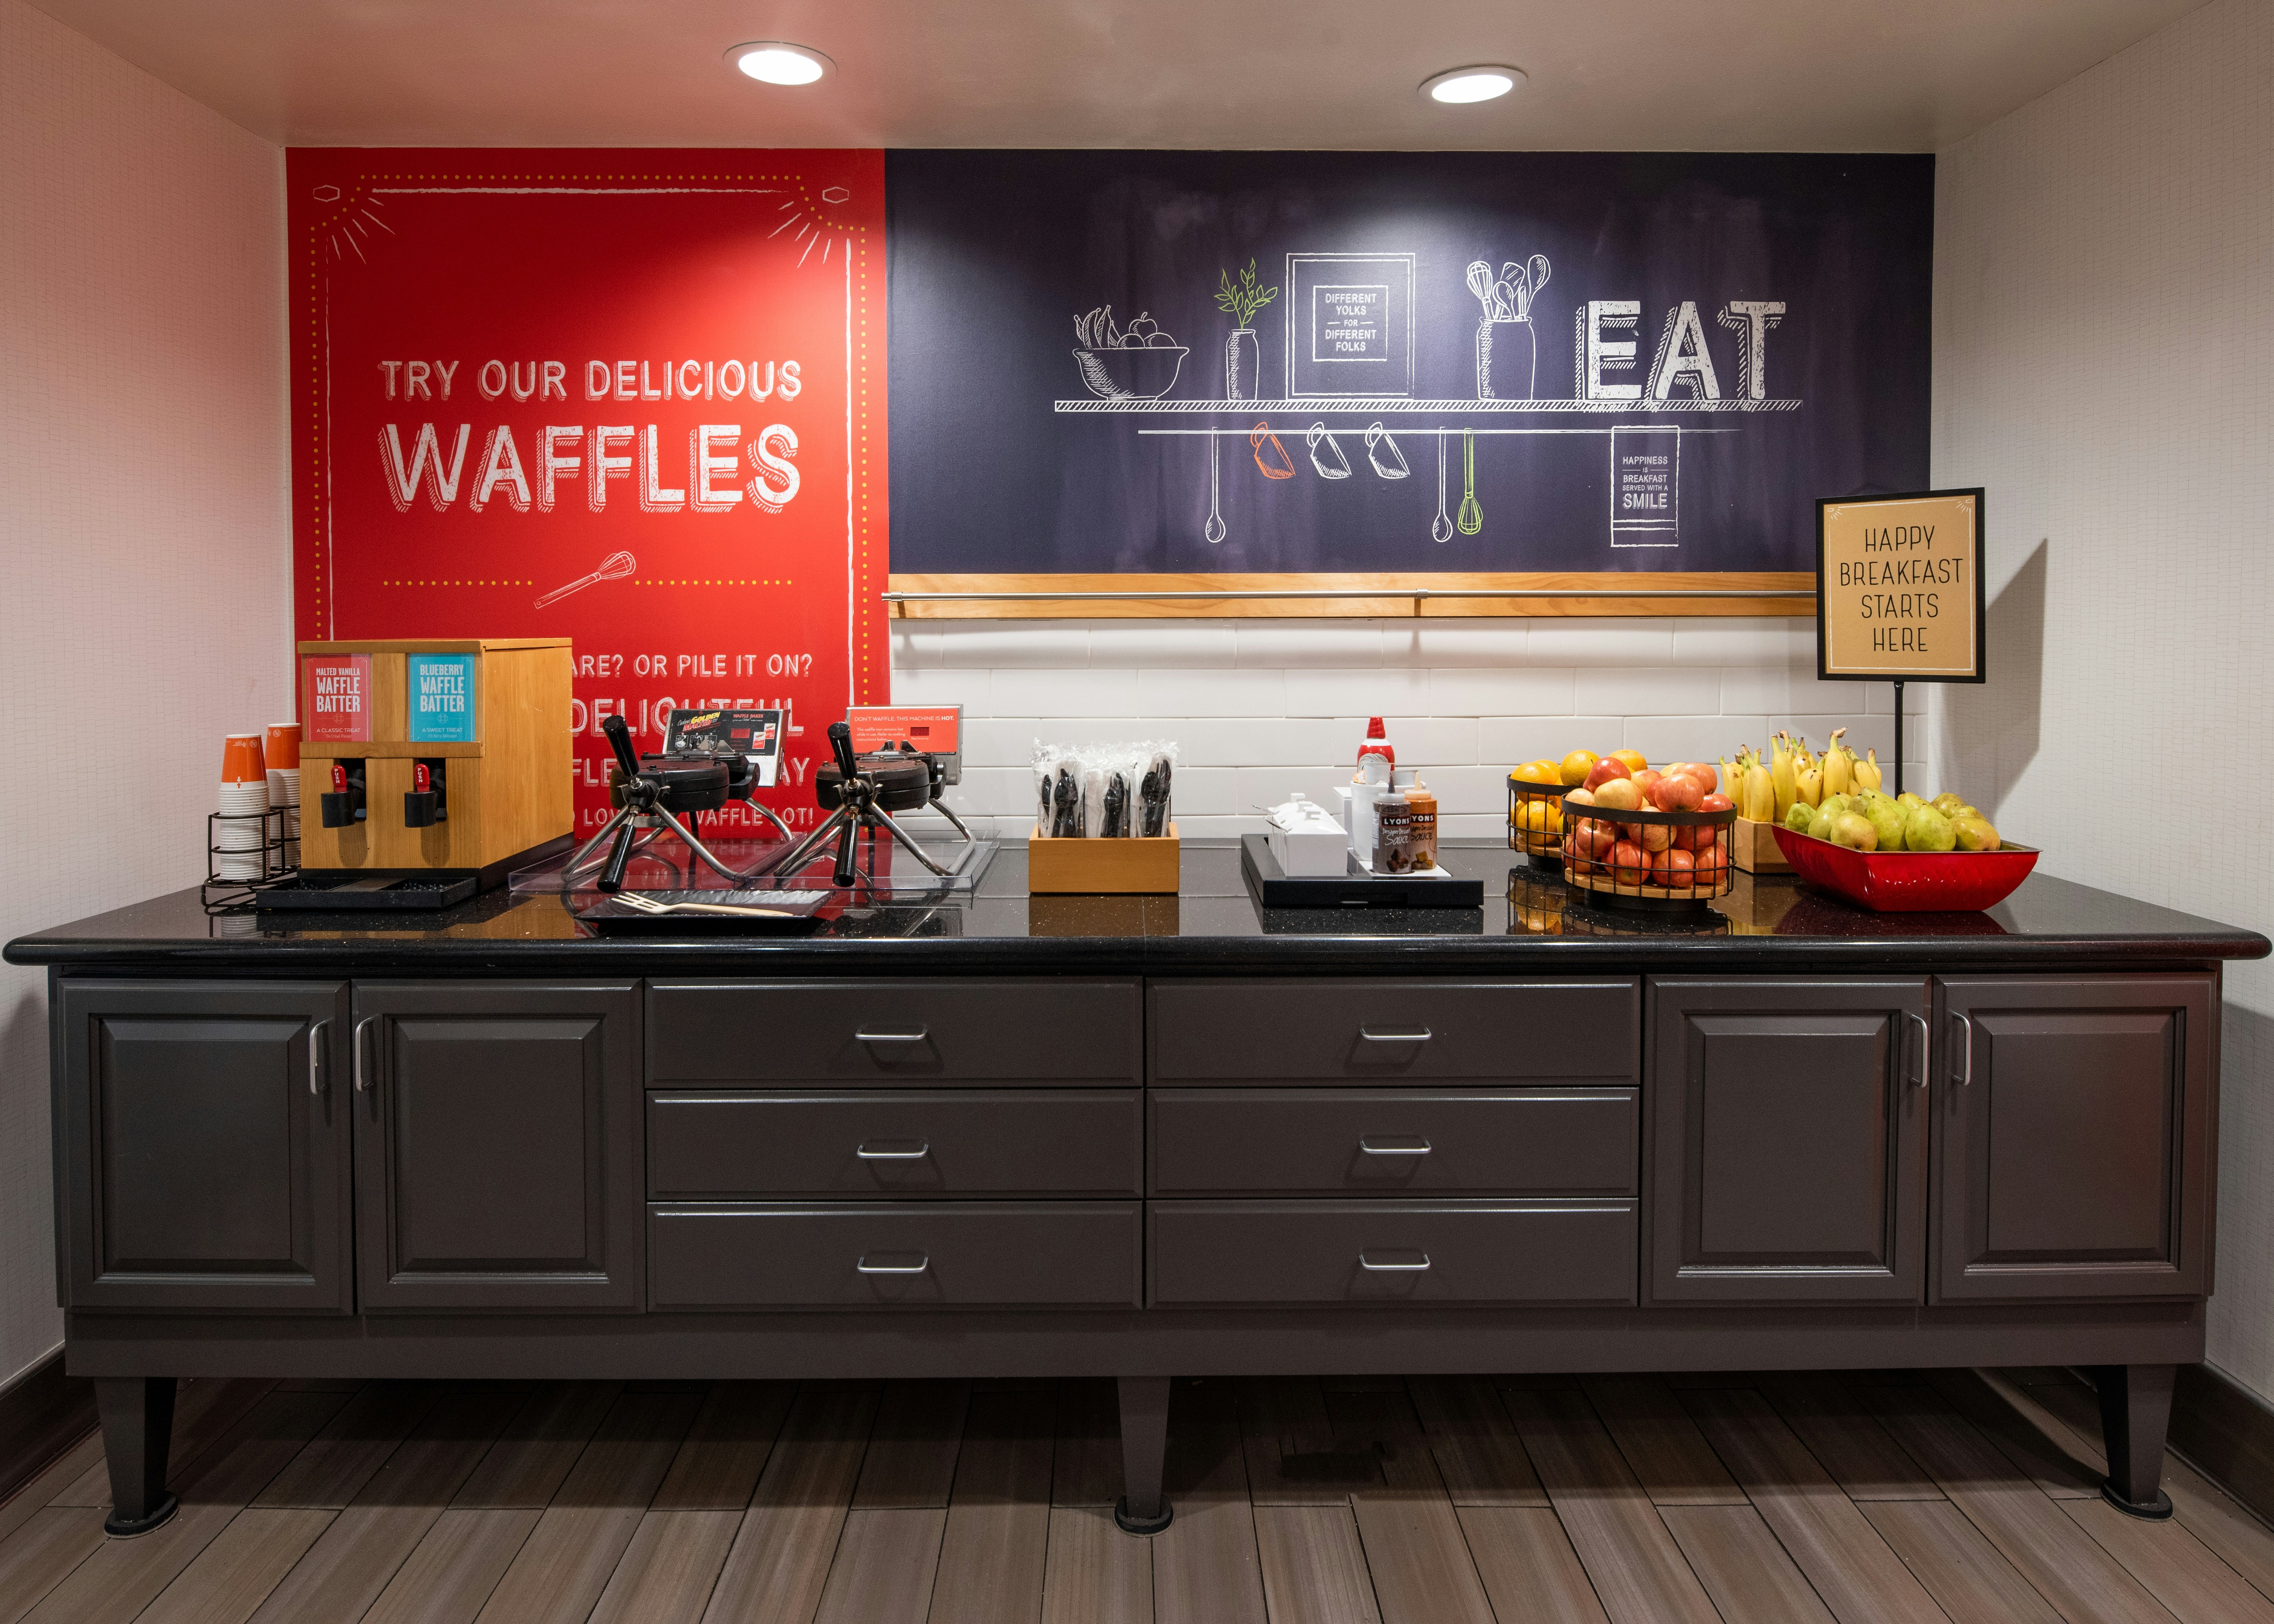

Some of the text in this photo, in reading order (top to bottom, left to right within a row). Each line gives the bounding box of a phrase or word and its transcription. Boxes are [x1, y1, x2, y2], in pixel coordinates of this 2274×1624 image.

[1325, 294, 1376, 303] DIFFERENT
[1336, 305, 1366, 315] YOLKS
[1325, 330, 1376, 340] DIFFERENT
[1336, 341, 1366, 352] FOLKS
[1576, 301, 1786, 410] EAT
[378, 359, 802, 402] TRY OUR DELICIOUS
[378, 423, 800, 514] WAFFLES
[1623, 456, 1668, 465] HAPPINESS
[1623, 475, 1667, 483] BREAKFAST
[1622, 493, 1667, 510] SMILE
[1865, 525, 1935, 552] HAPPY
[1840, 558, 1963, 586] BREAKFAST
[1861, 593, 1939, 619] STARTS
[1873, 627, 1928, 652] HERE
[339, 668, 360, 676] VANILLA
[420, 664, 464, 675] BLUEBERRY
[634, 654, 667, 678] OR
[678, 654, 727, 677] PILE
[736, 654, 756, 677] IT
[766, 653, 813, 678] ON?
[316, 677, 360, 694] WAFFLE
[420, 677, 464, 694] WAFFLE
[316, 695, 360, 712] BATTER
[420, 695, 464, 712] BATTER
[572, 697, 804, 737] DELIGL
[682, 719, 712, 732] MALTED
[691, 712, 720, 724] GOLDEN
[771, 808, 813, 826] OT!
[1385, 834, 1408, 846] Sauce
